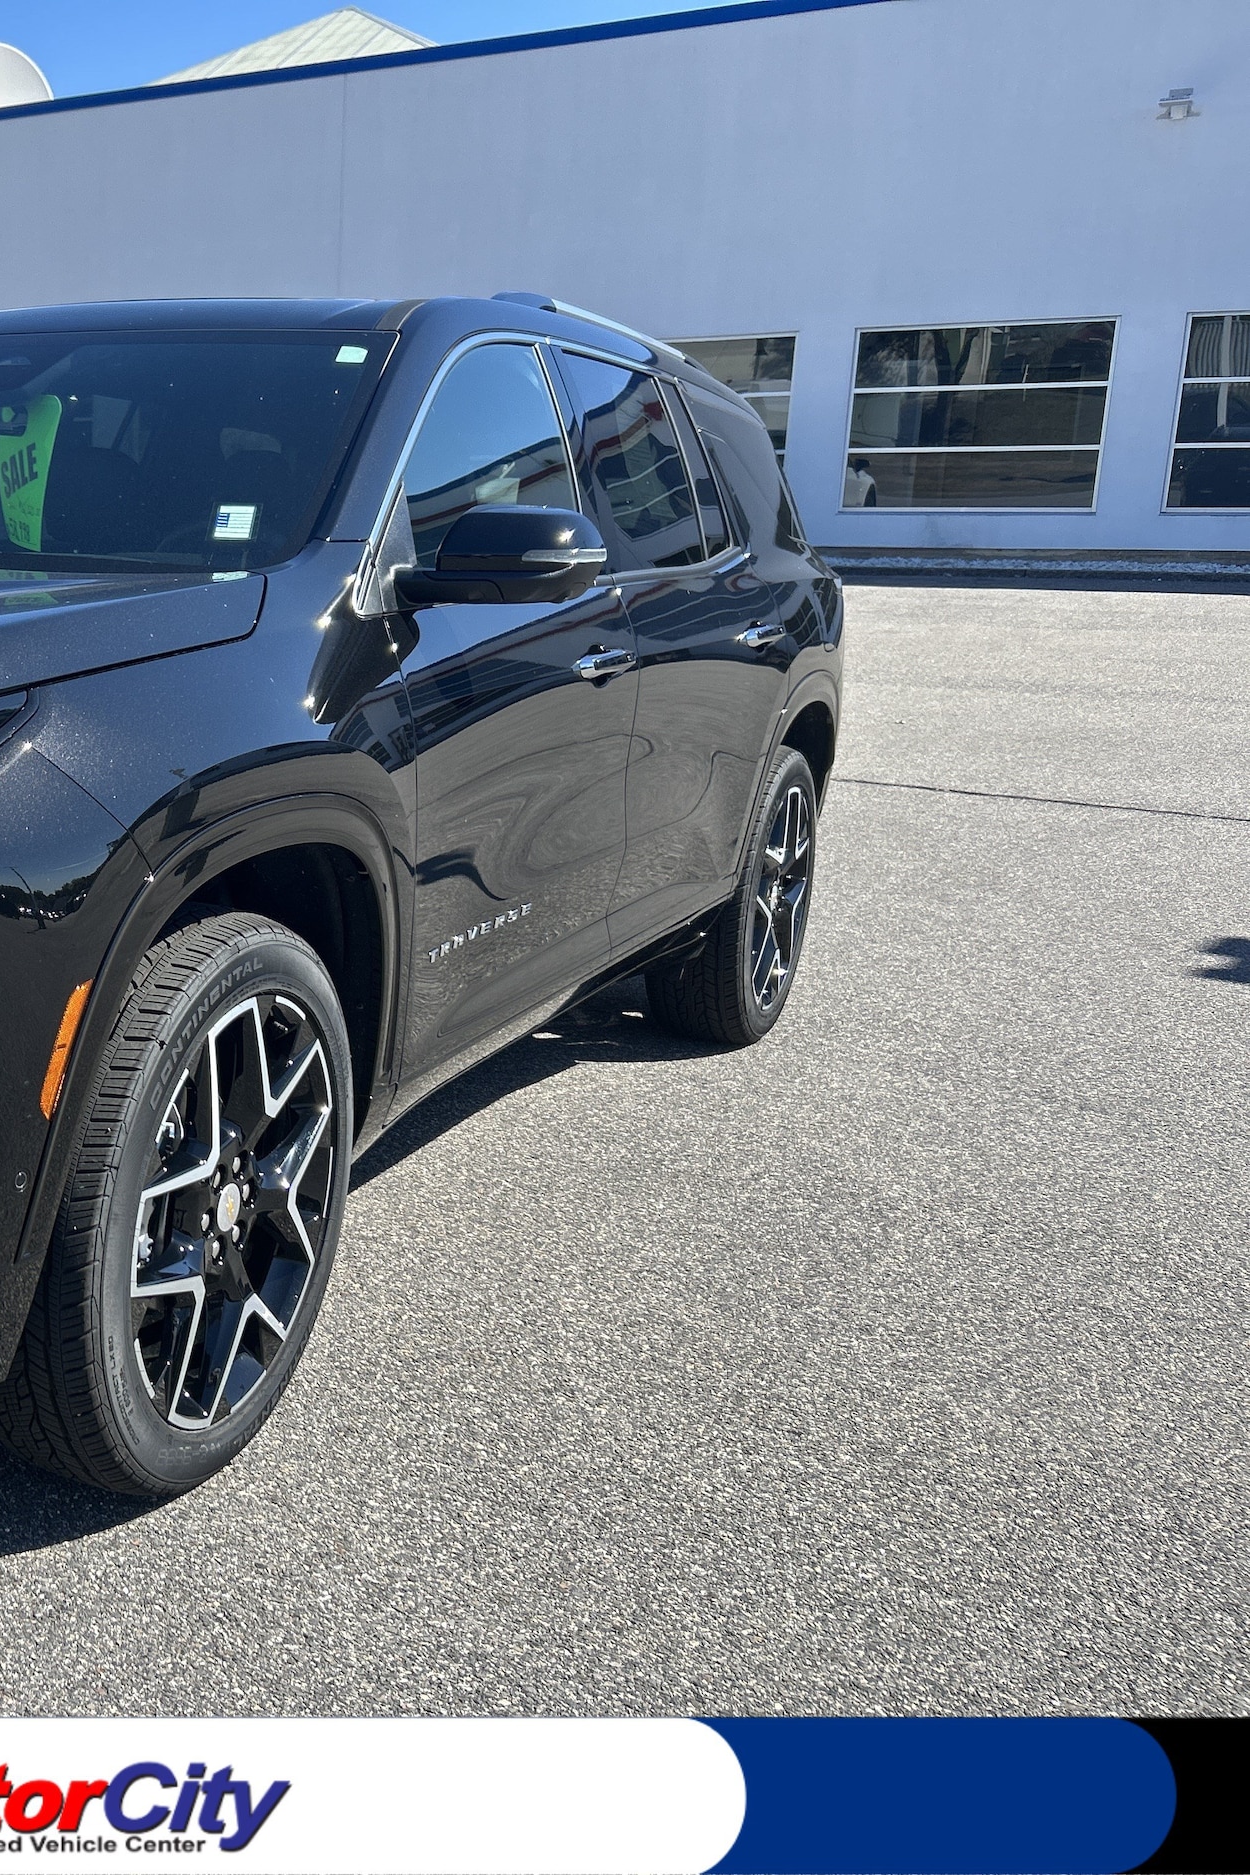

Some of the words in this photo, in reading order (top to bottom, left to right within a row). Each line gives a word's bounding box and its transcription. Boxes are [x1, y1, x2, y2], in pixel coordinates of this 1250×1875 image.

[0, 442, 38, 499] SALE
[428, 902, 532, 963] TRAVERSE
[150, 956, 263, 1111] CONTINENTAL
